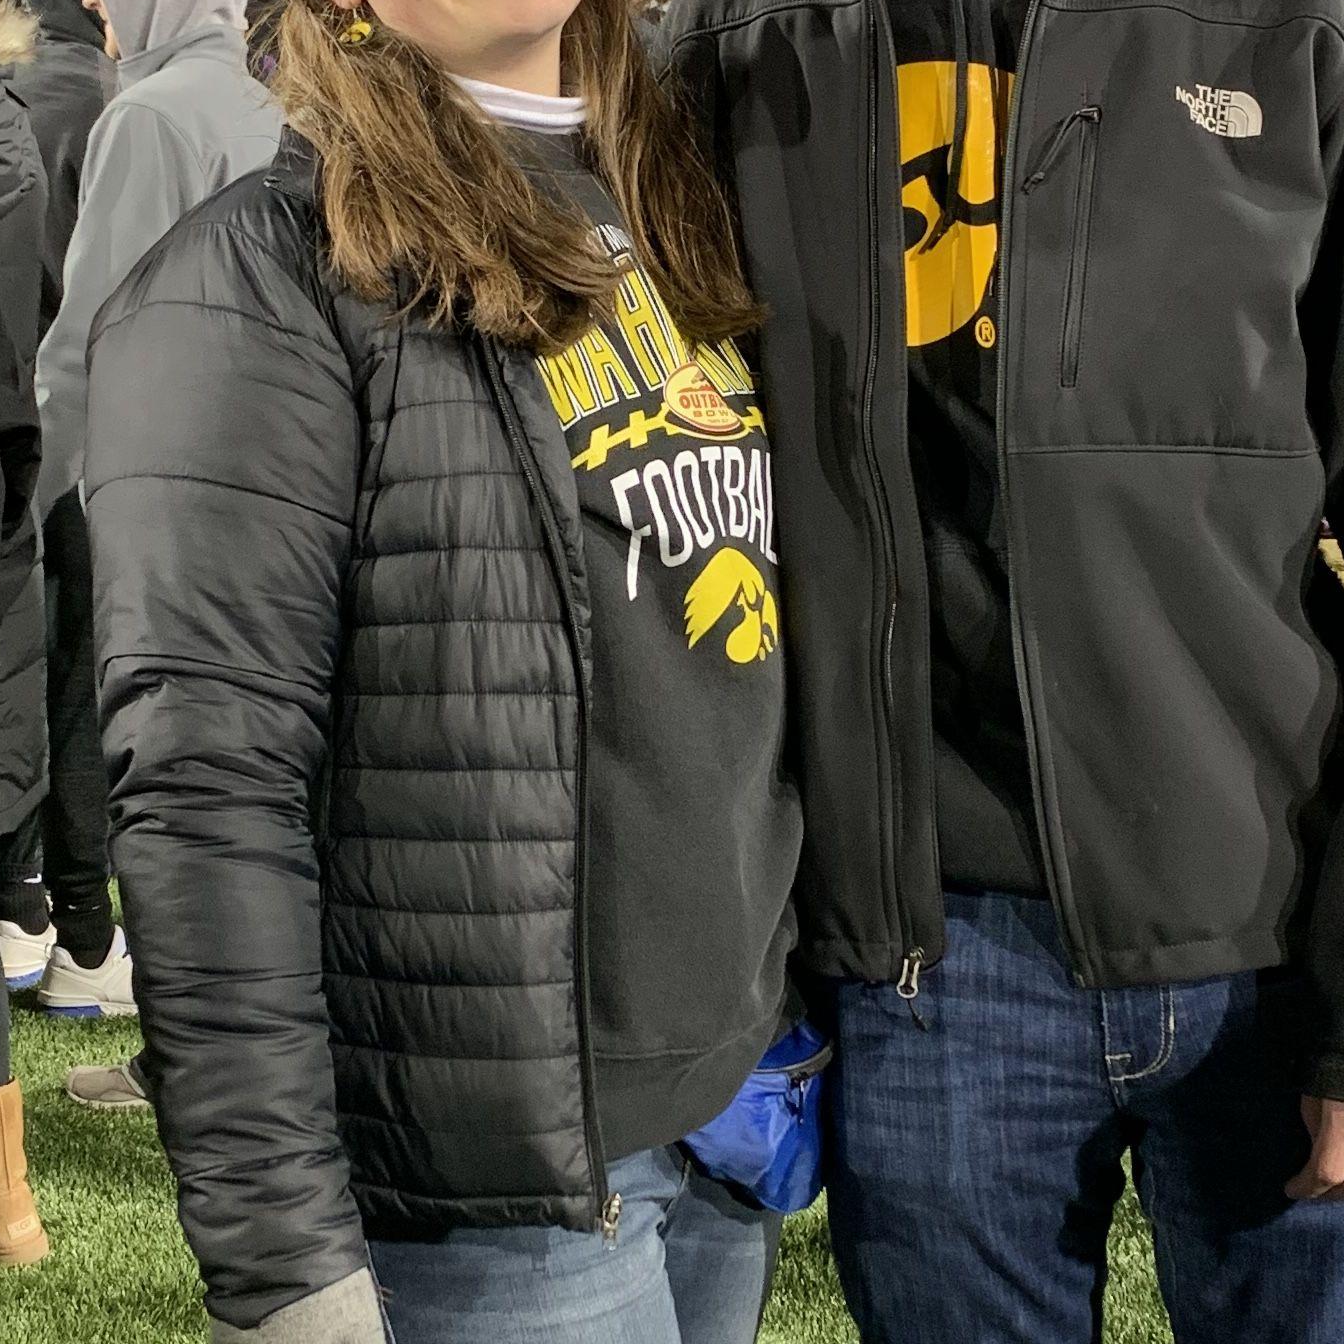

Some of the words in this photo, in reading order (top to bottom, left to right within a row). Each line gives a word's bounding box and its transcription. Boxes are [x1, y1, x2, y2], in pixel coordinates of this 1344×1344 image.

[1175, 85, 1230, 121] NORTH
[1195, 83, 1231, 105] THE
[1190, 108, 1229, 136] FACE
